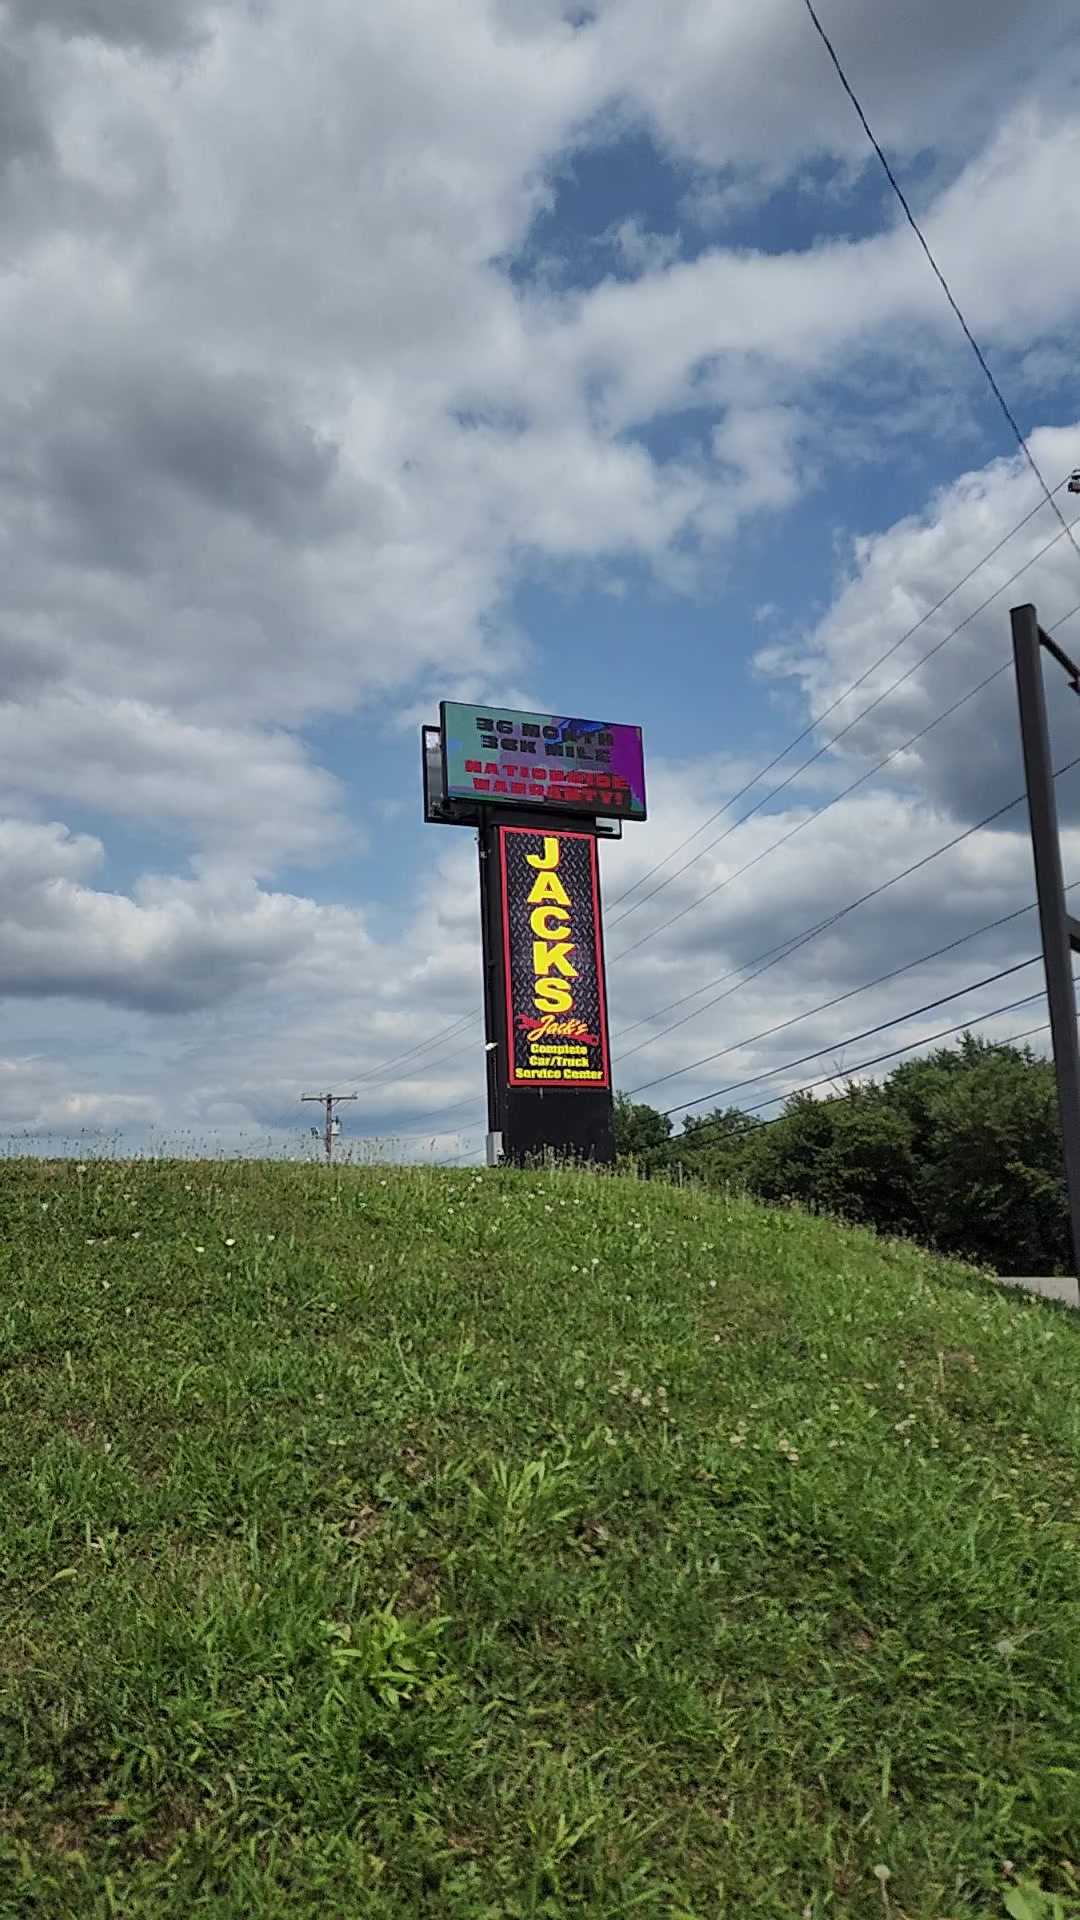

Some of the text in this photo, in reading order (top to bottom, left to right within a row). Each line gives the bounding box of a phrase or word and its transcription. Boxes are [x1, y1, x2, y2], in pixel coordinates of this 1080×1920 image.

[476, 717, 613, 746] 36 MOTH
[525, 837, 580, 1014] JACKS
[527, 1014, 588, 1041] Jack's
[530, 1044, 588, 1055] Complete
[529, 1056, 589, 1067] Car/Truck
[515, 1068, 603, 1079] Service Center
